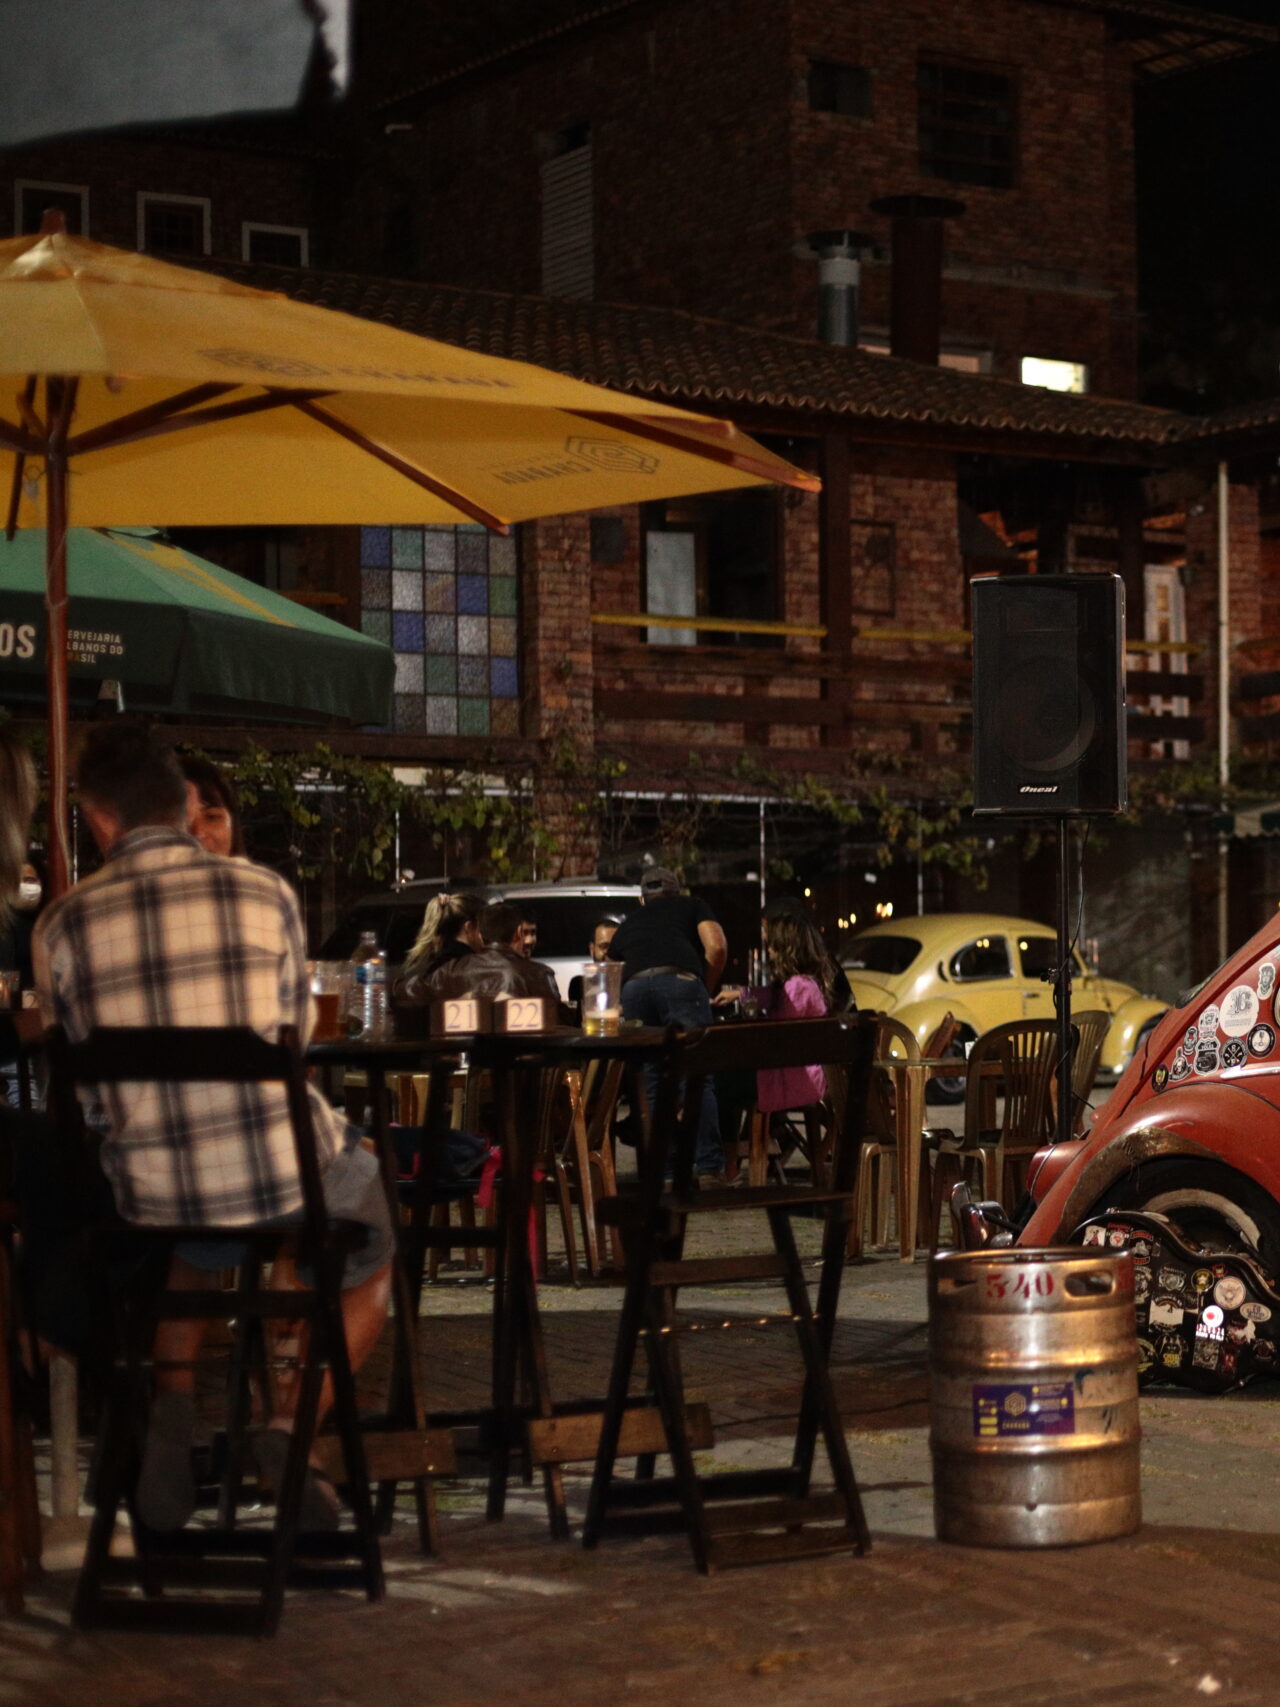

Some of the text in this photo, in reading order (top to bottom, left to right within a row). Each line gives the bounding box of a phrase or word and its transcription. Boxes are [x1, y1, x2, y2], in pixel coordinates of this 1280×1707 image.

[67, 630, 121, 644] ERVEJARIA
[67, 642, 107, 654] LBANOS
[447, 1002, 474, 1029] 21
[510, 1002, 539, 1028] 22
[986, 1270, 1055, 1299] 540
